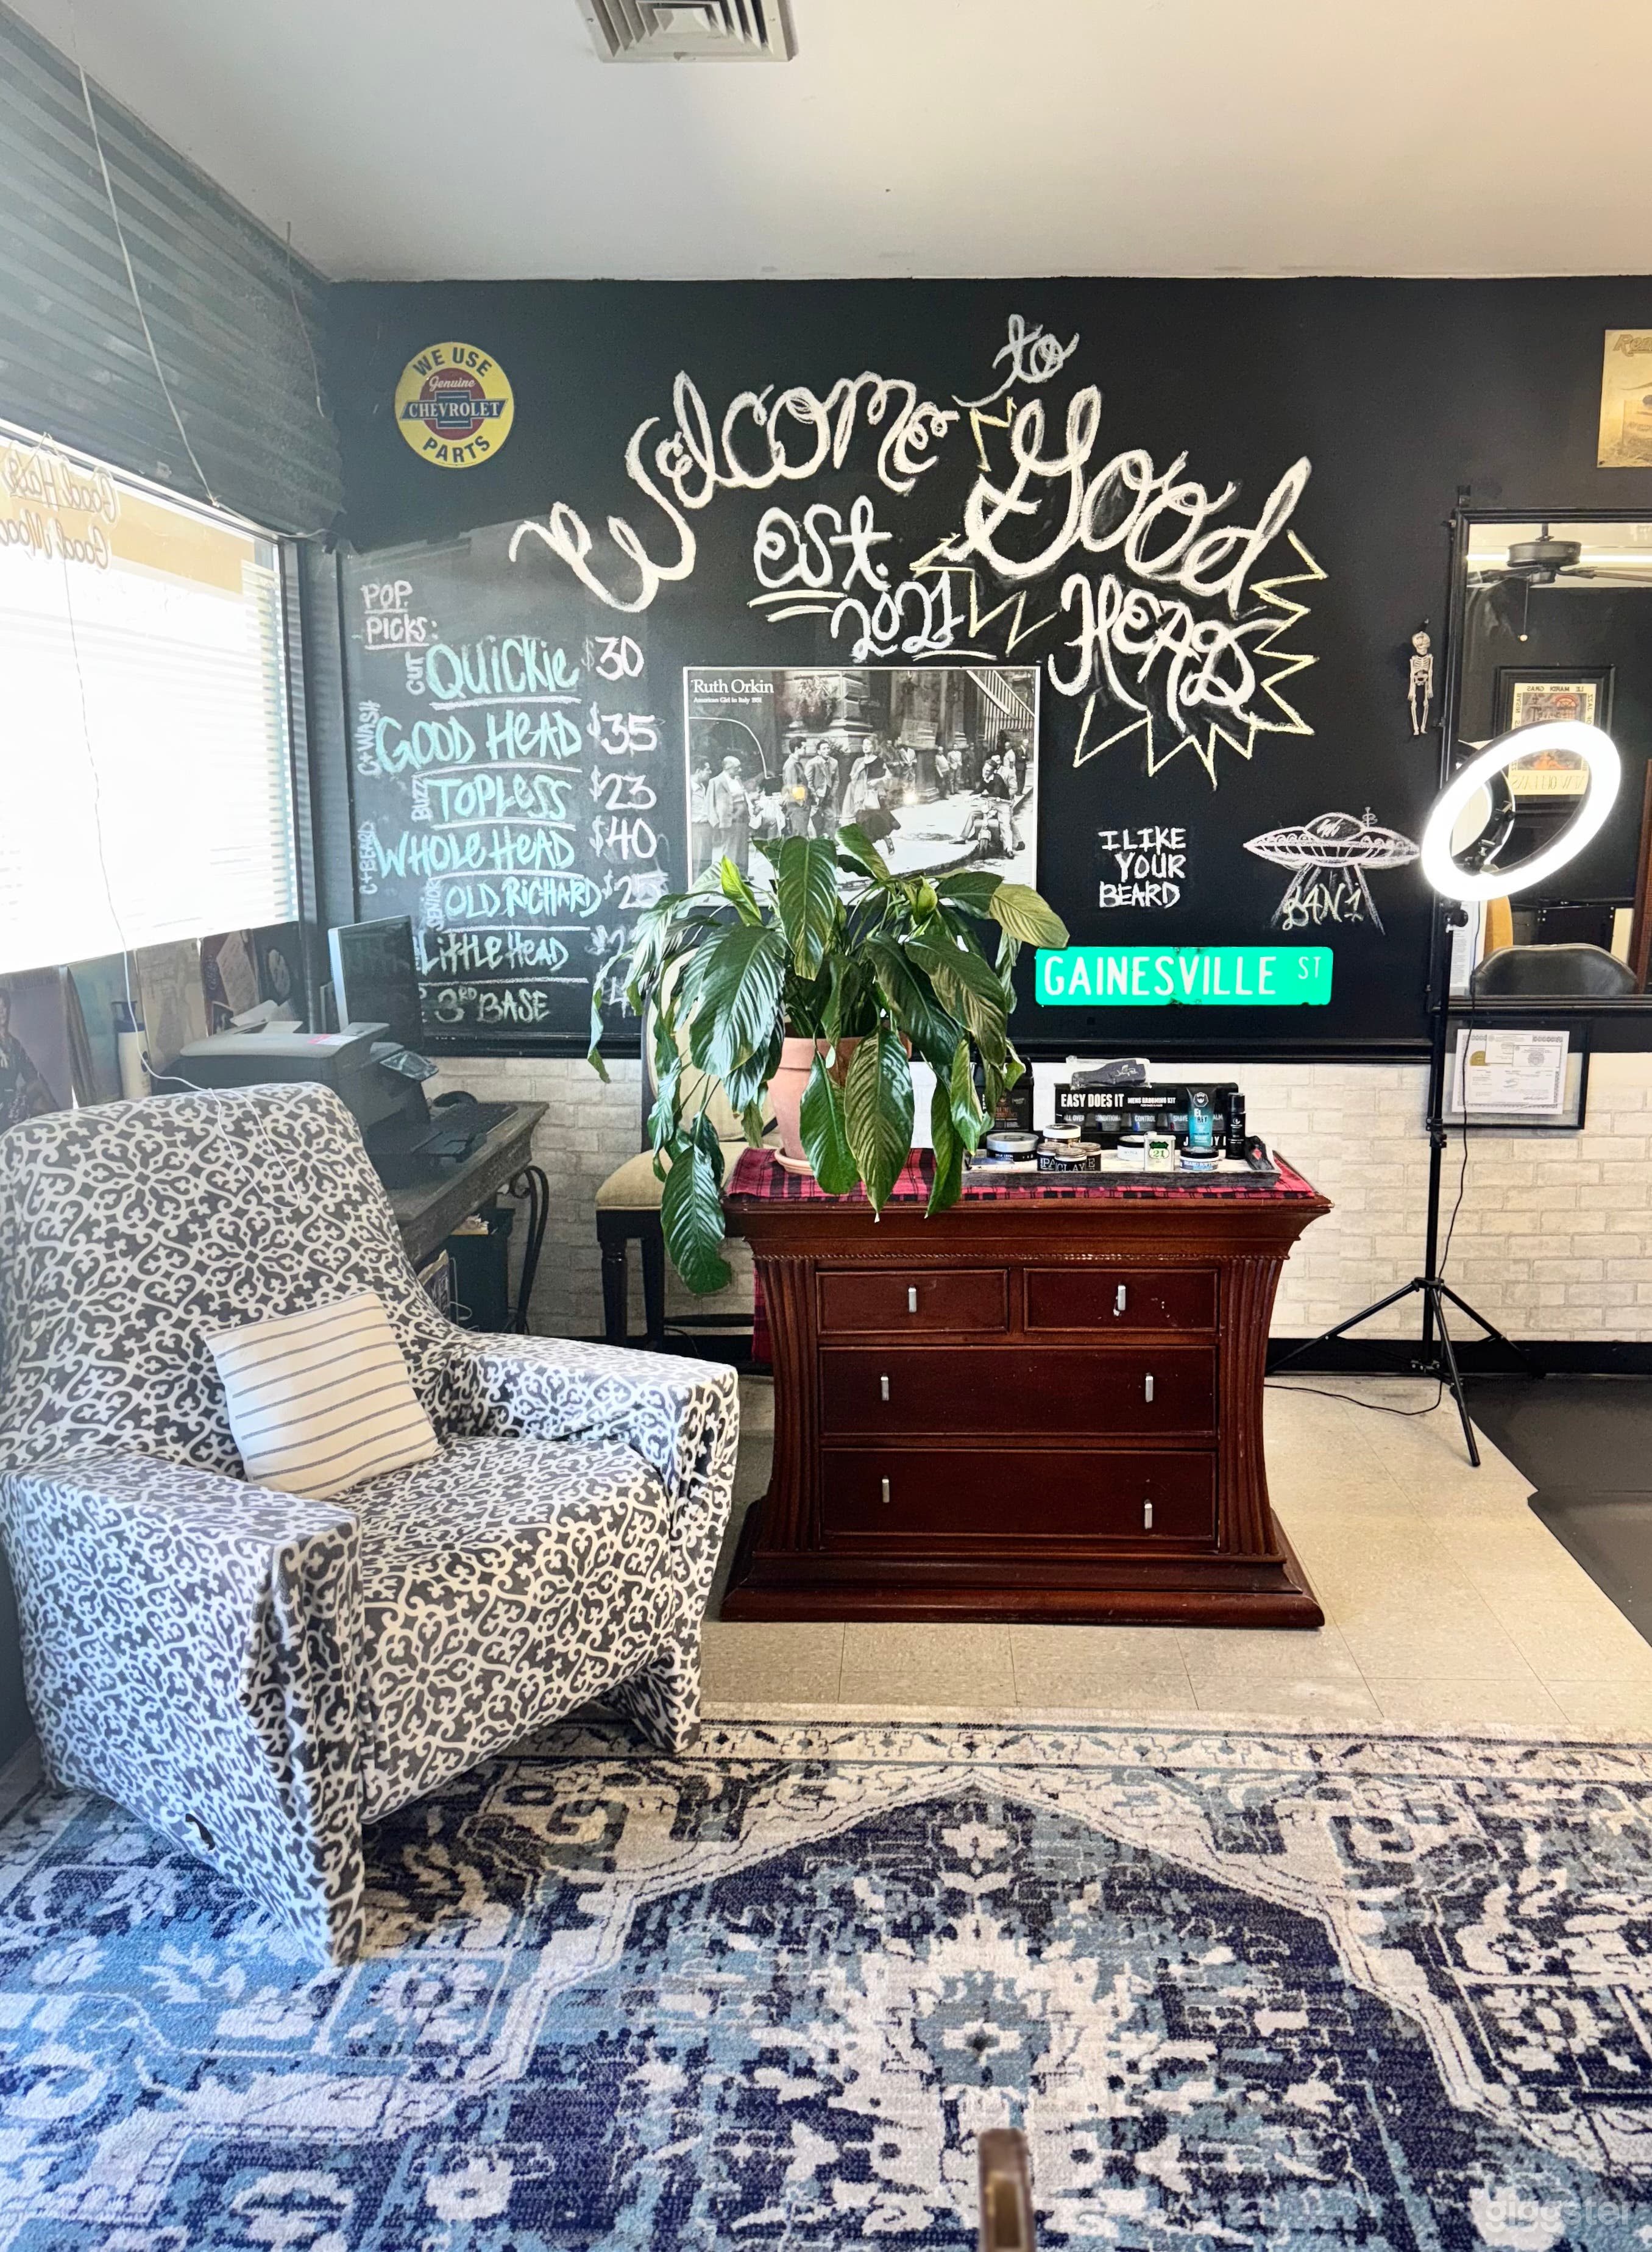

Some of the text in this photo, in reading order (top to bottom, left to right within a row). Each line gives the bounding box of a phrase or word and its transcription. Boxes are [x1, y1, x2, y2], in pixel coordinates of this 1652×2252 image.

[413, 347, 492, 377] WE USE
[966, 313, 1079, 405] to
[429, 375, 476, 392] Genuine
[409, 402, 500, 418] CHEVROLET
[422, 436, 491, 463] PARTS
[508, 370, 960, 614] Welcome
[405, 651, 427, 696] CUT
[580, 636, 644, 681] $30
[690, 678, 775, 694] Ruth Orkin
[375, 715, 477, 773] GOOD
[587, 702, 659, 755] $35
[411, 775, 433, 823] BUZZ
[589, 765, 658, 811] $23
[591, 815, 658, 861] $40
[1099, 825, 1187, 854] I LIKE
[1114, 853, 1186, 884] YOUR
[445, 883, 501, 919] OLD
[1099, 880, 1180, 909] BEARD
[1043, 955, 1321, 996] GAINESVILLE ST
[476, 987, 551, 1024] BASE
[1061, 1093, 1124, 1107] EASY DOES IT
